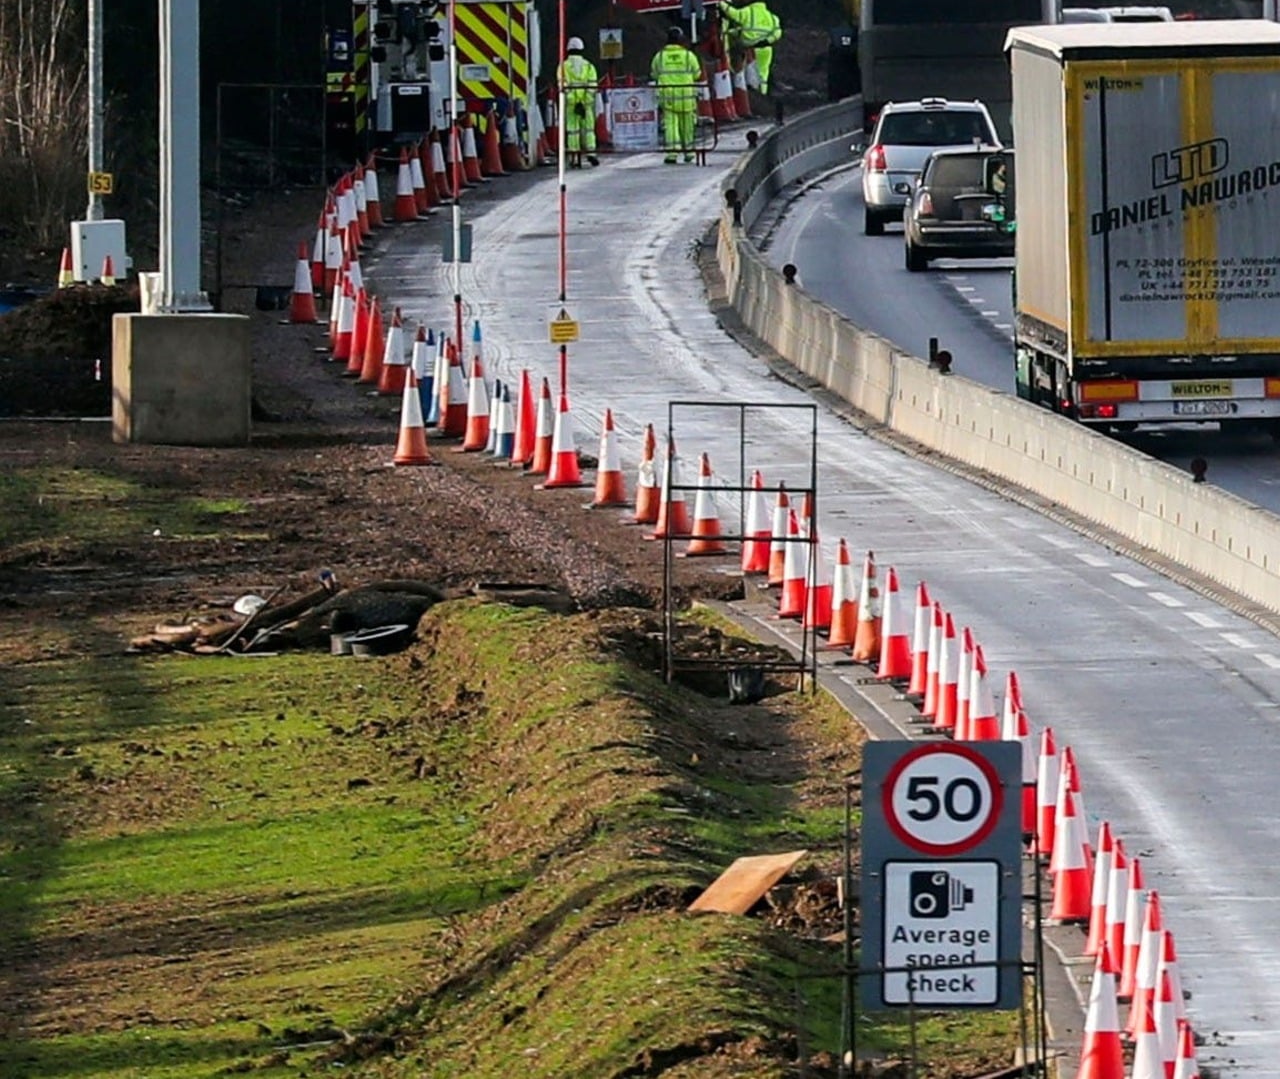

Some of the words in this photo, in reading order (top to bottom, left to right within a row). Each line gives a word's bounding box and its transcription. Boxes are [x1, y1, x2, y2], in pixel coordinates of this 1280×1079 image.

[1083, 80, 1133, 89] WILTON
[1152, 137, 1229, 190] LTD
[1091, 194, 1173, 236] DANIEL
[1172, 384, 1220, 394] WIELTON
[906, 776, 982, 822] 50
[891, 925, 991, 947] Average
[906, 950, 976, 970] speed
[905, 974, 976, 993] check
